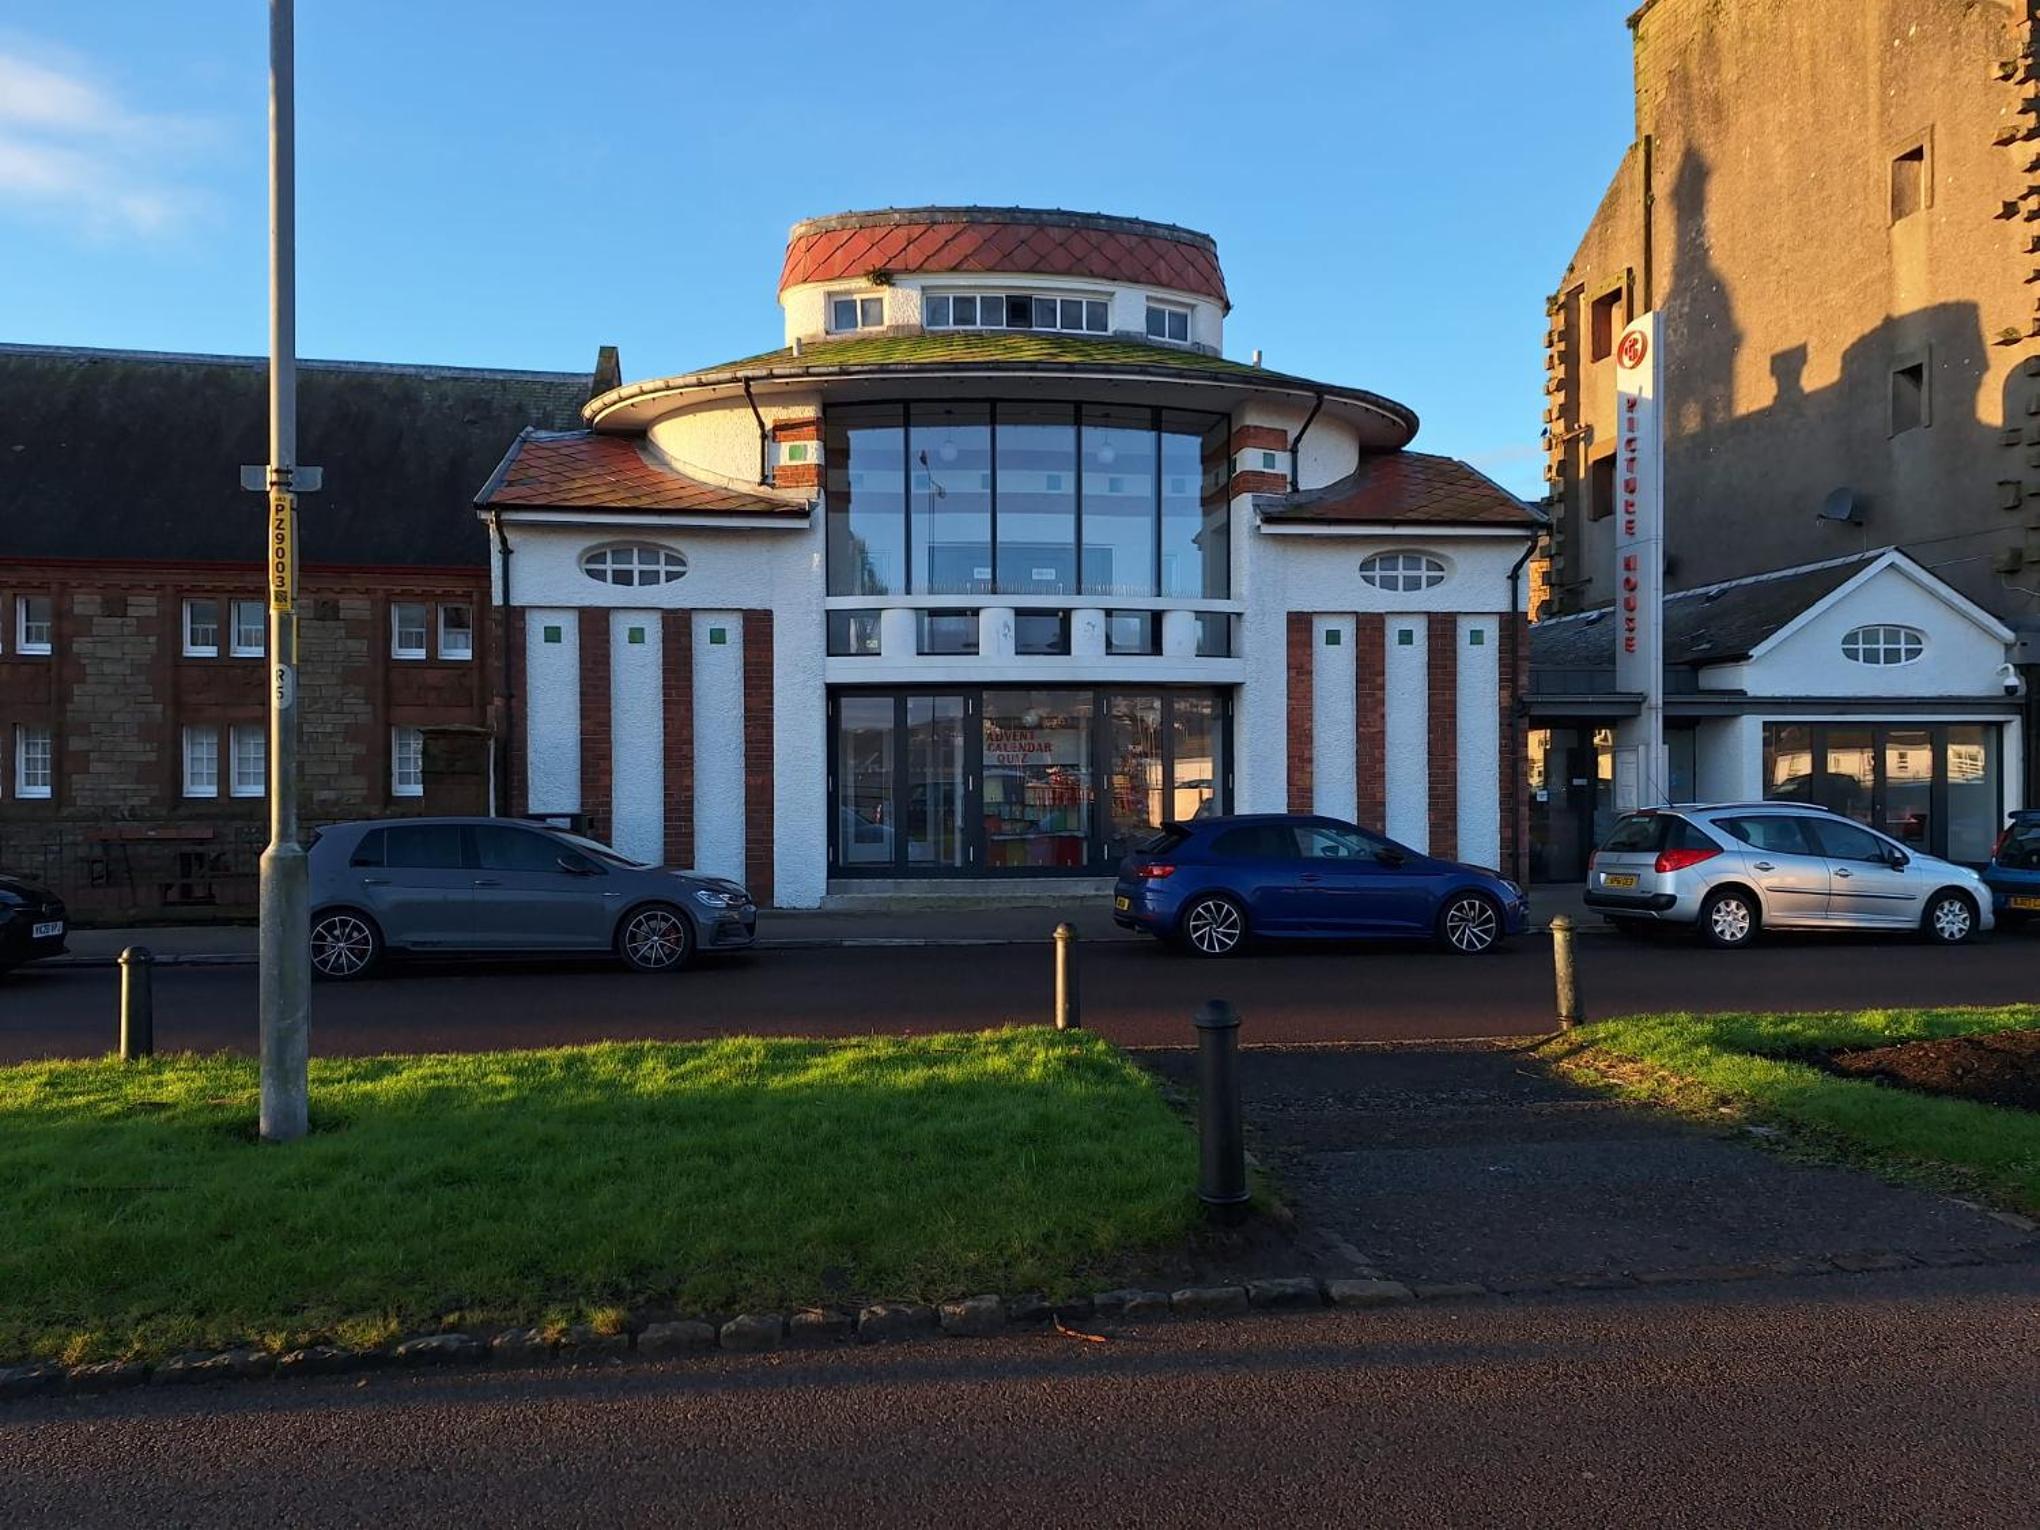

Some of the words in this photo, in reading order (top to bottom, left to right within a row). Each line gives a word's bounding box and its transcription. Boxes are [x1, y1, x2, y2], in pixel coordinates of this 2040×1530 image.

[1623, 397, 1638, 536] PICTURE
[275, 503, 286, 588] PZ9003
[1623, 555, 1638, 654] HOUSE
[986, 729, 1035, 742] ADVENT
[987, 742, 1053, 753] CALENDAR
[997, 753, 1028, 764] QUIZ
